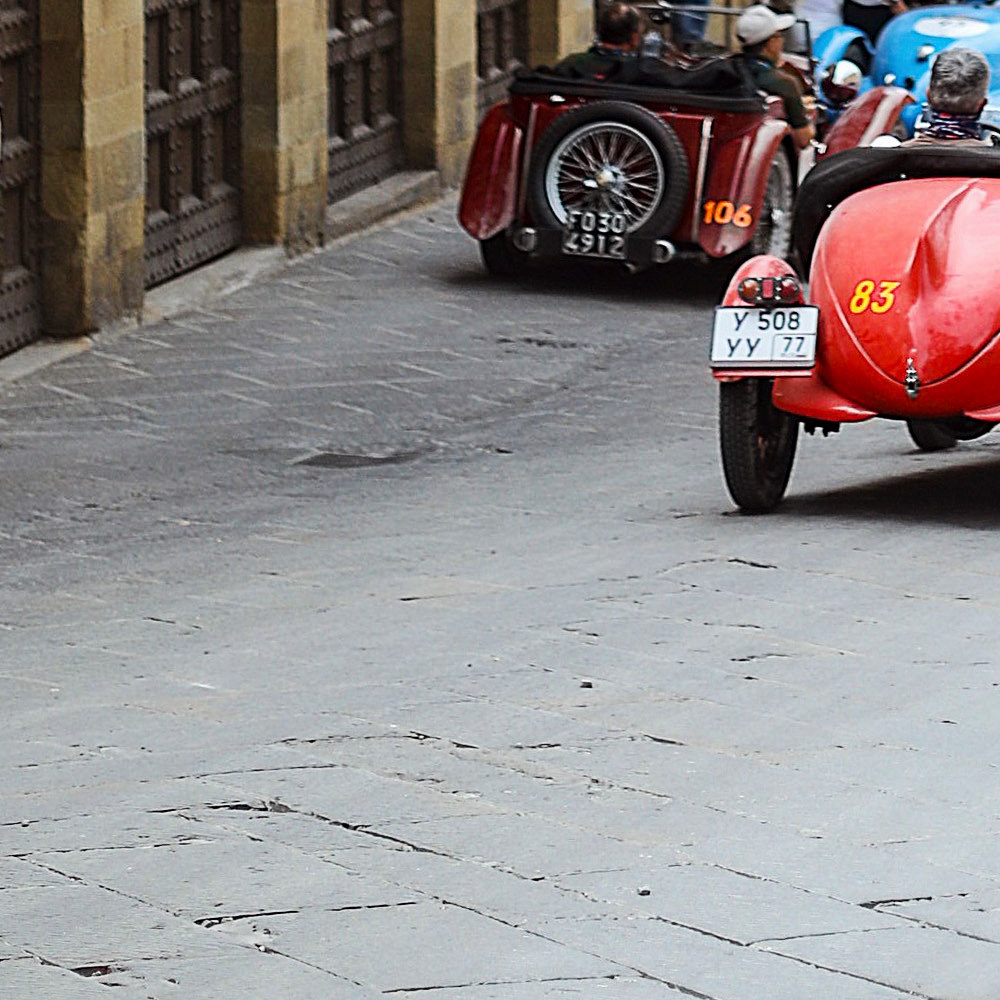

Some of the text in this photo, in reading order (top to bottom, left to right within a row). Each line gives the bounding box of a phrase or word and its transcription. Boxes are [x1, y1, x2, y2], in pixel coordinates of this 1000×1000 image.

[703, 200, 753, 228] 106
[850, 279, 901, 315] 83
[758, 311, 800, 330] 508
[783, 336, 805, 352] 77
